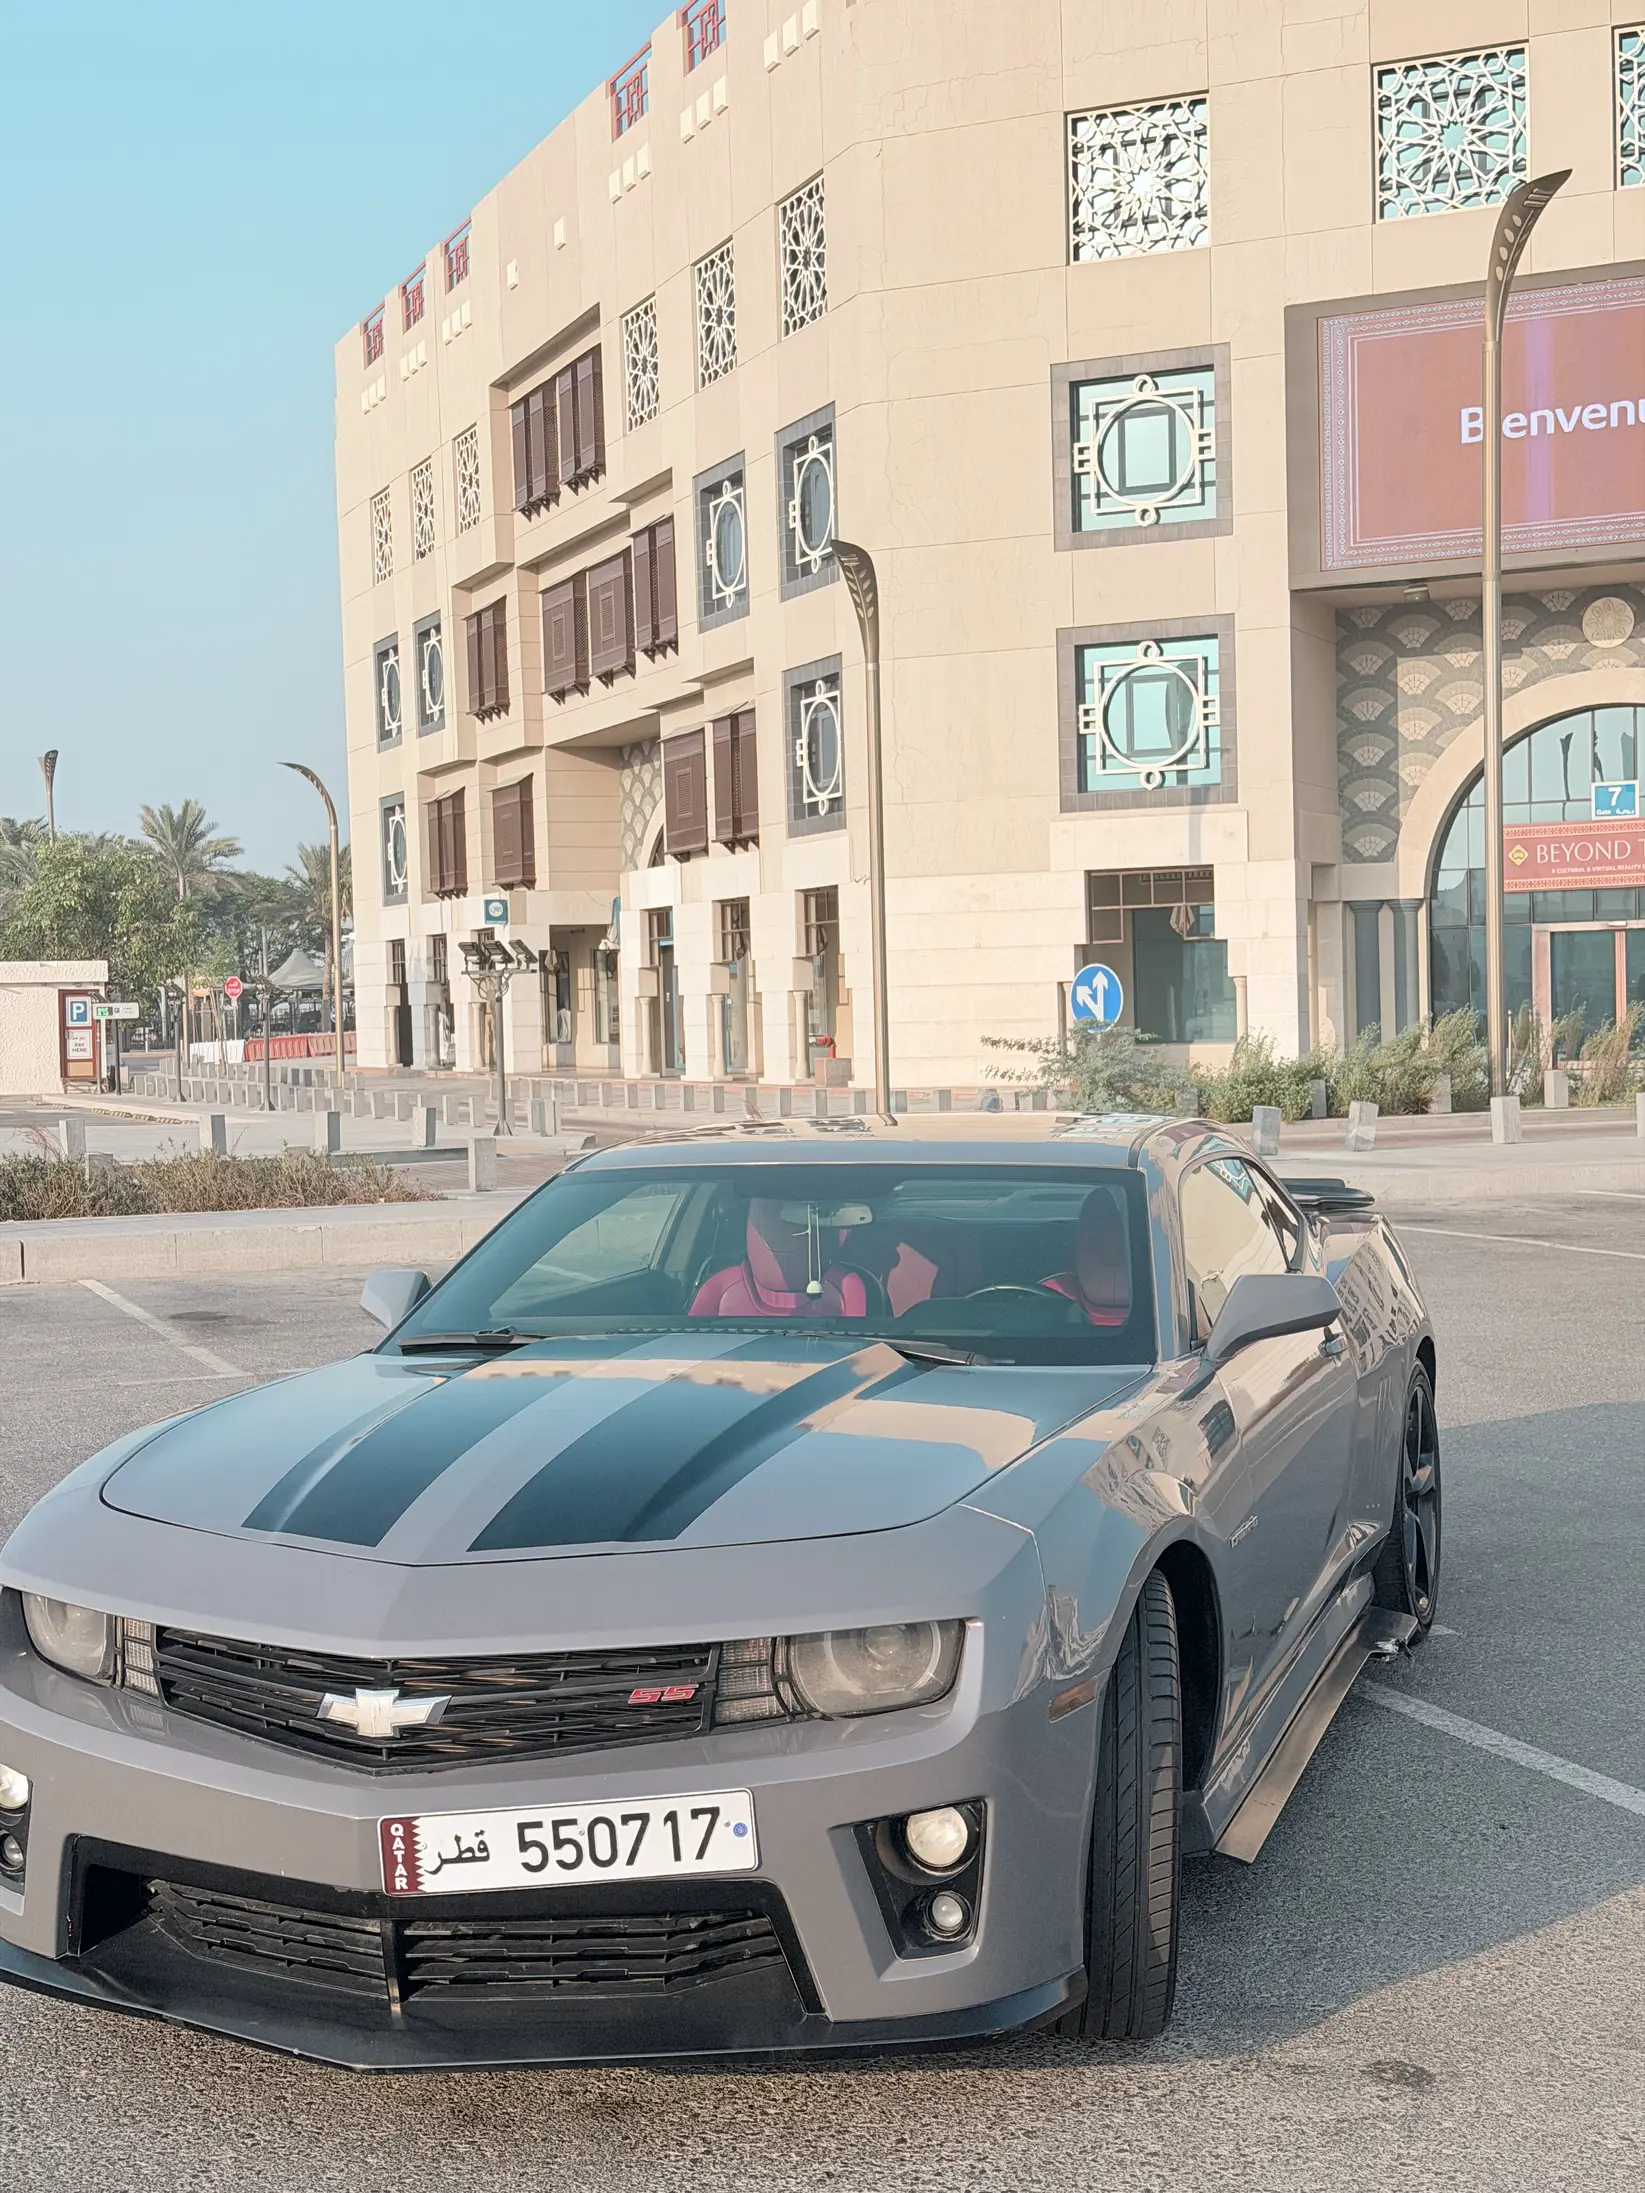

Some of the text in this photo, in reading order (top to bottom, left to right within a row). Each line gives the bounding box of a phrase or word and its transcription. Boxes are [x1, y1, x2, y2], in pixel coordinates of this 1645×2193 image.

[1461, 399, 1645, 444] Benven
[1608, 787, 1622, 807] 7
[1537, 840, 1631, 864] BEYOND
[1557, 866, 1585, 874] CULTURAL
[72, 1002, 85, 1021] P
[627, 1683, 700, 1705] SS
[390, 1823, 409, 1890] QATAR
[423, 1829, 490, 1875] قطر
